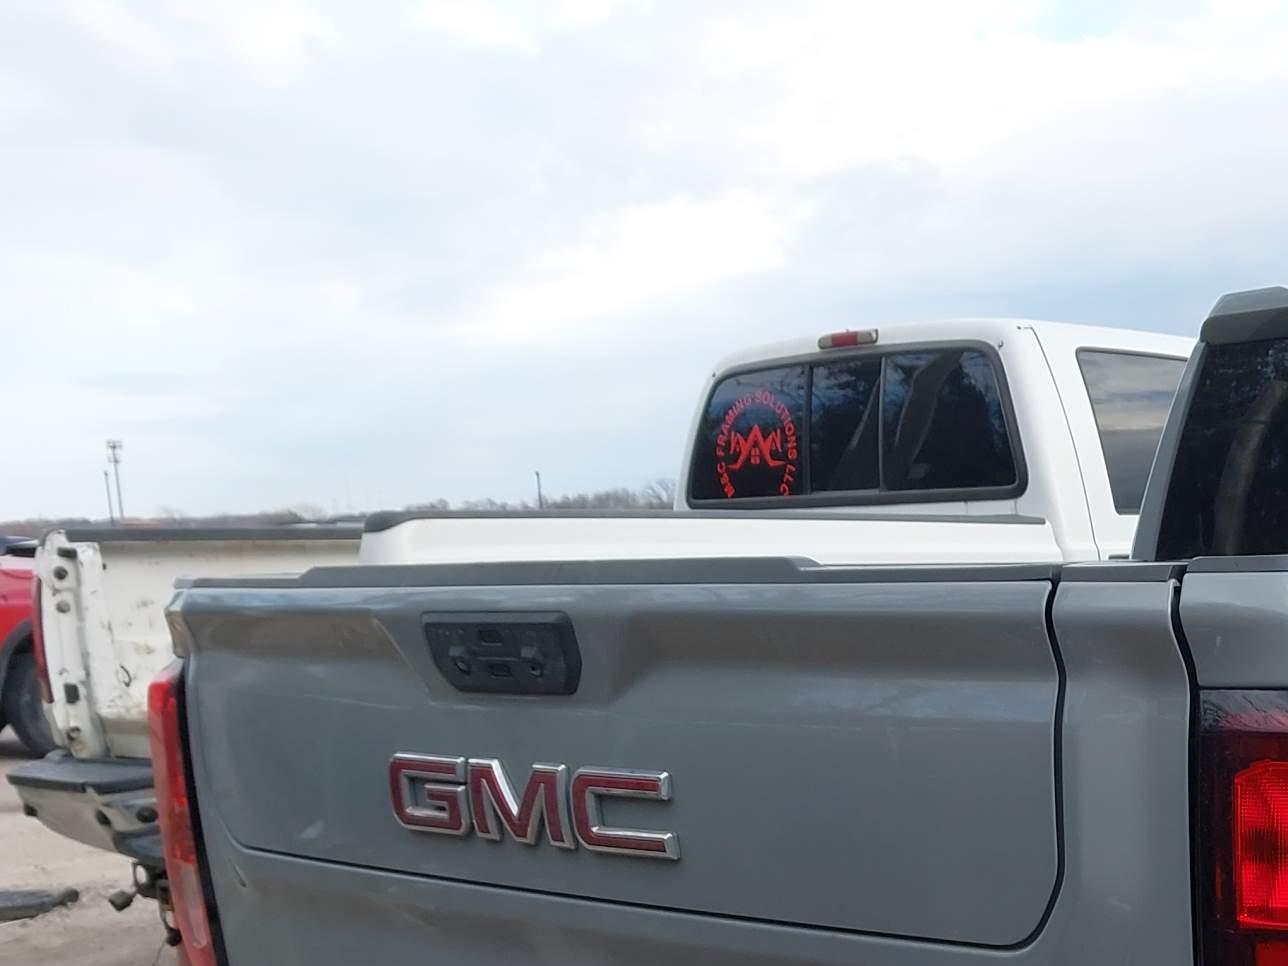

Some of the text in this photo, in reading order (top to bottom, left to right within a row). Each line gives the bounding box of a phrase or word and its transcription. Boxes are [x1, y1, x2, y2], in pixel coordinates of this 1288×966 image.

[716, 394, 752, 457] FRAMING
[756, 391, 797, 460] SOLUTIONS
[780, 463, 796, 496] LLC
[388, 752, 681, 861] GMC
